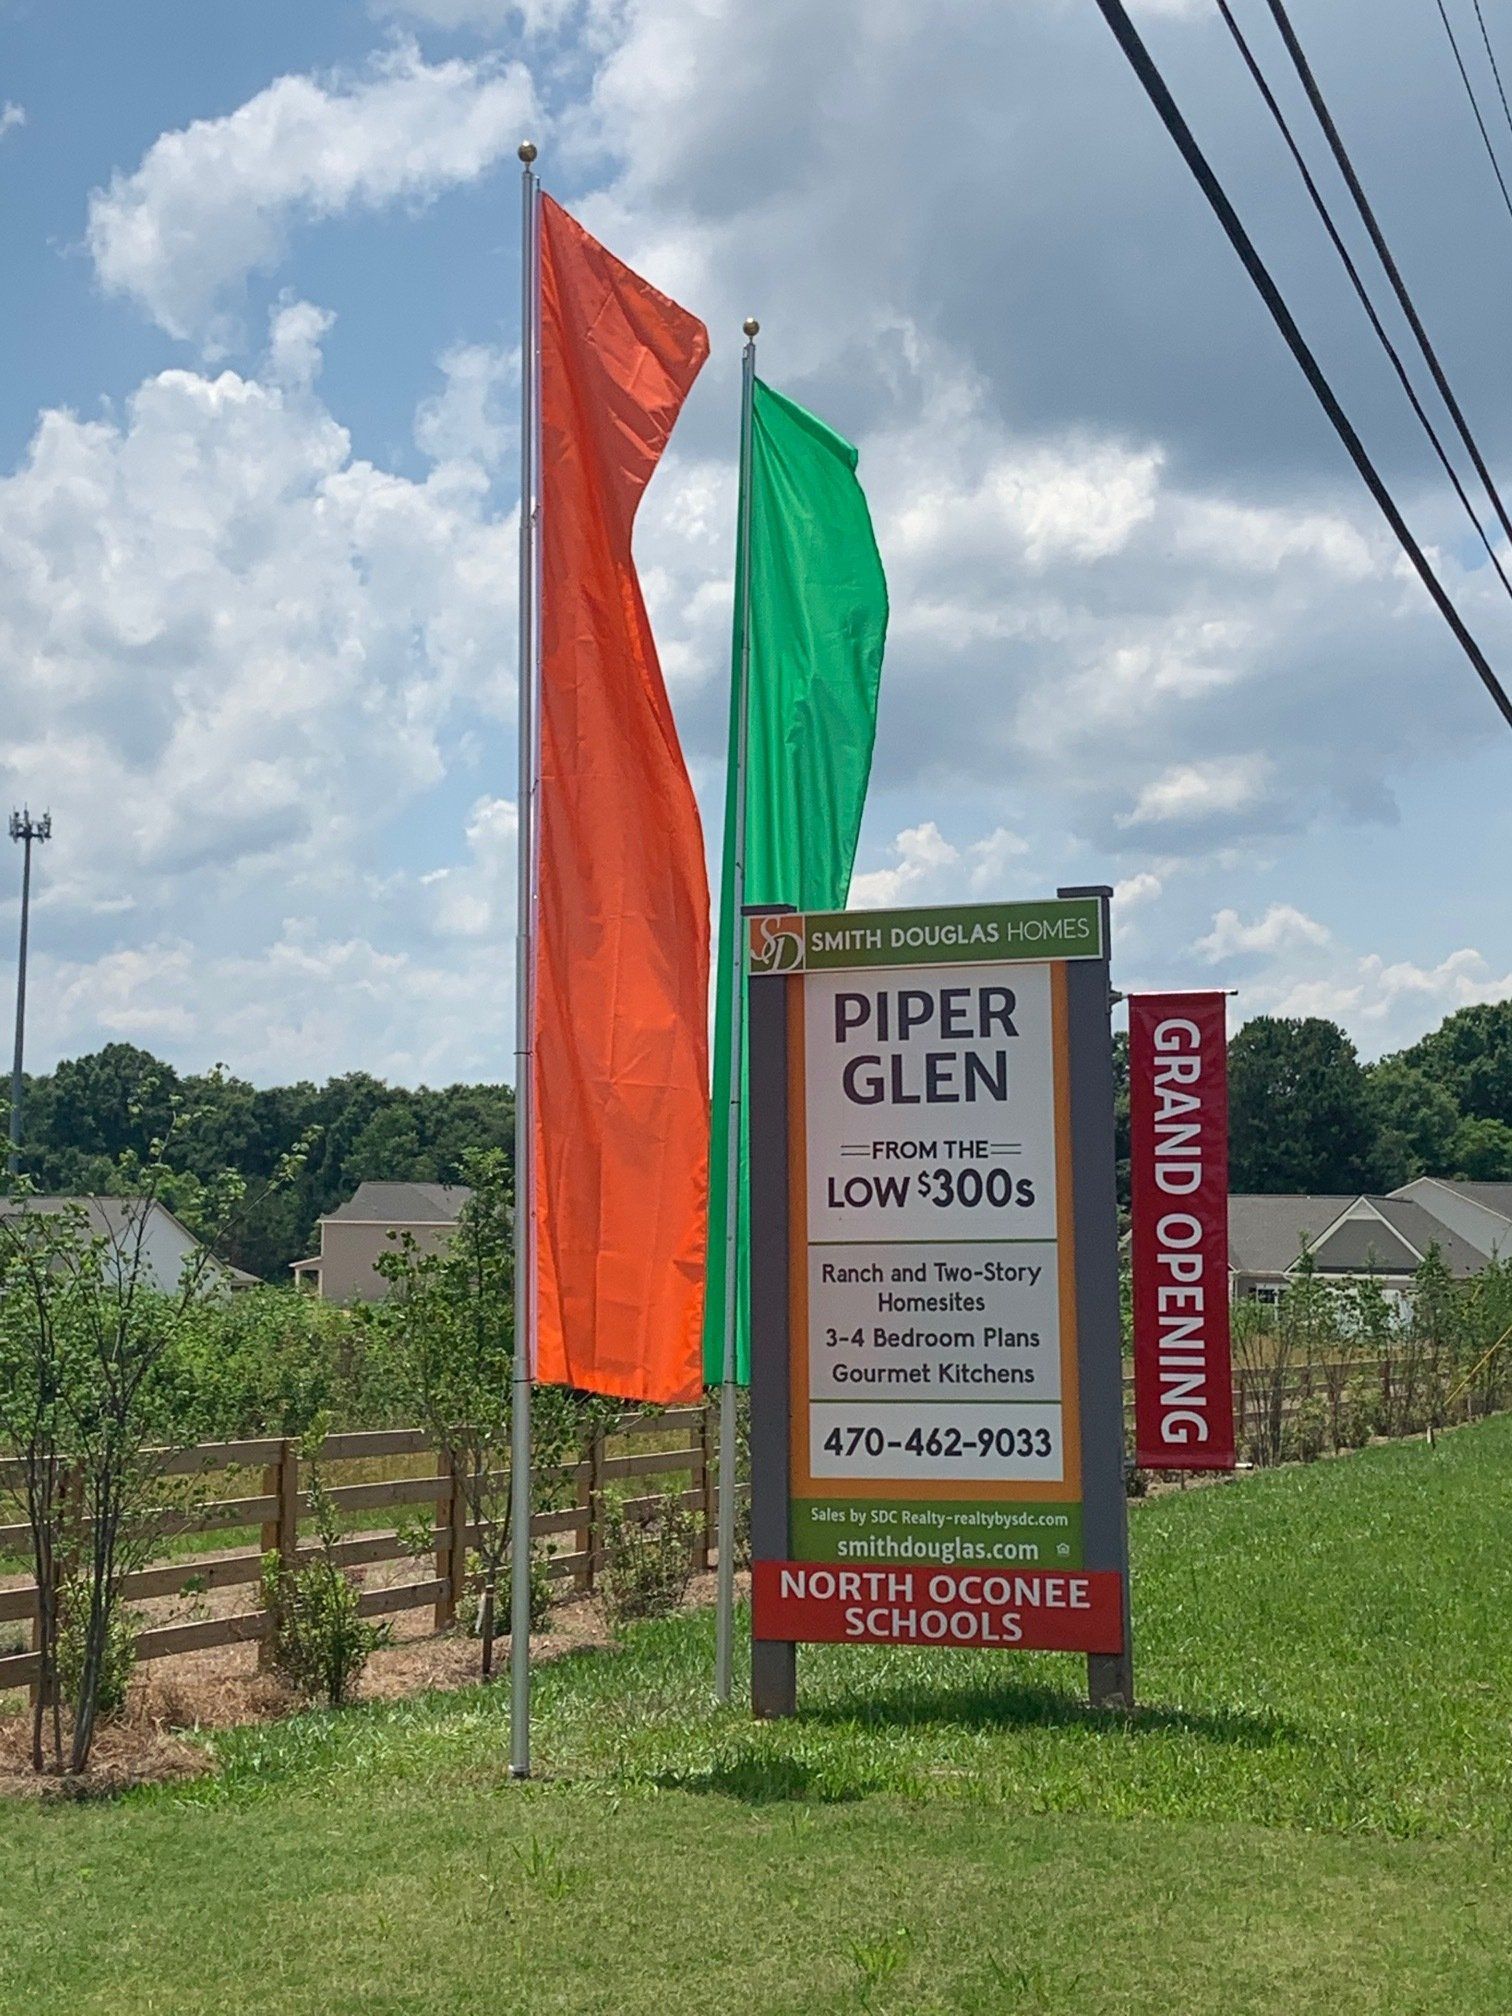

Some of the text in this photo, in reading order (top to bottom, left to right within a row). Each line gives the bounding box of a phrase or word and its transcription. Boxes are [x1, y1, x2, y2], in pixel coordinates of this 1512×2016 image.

[812, 917, 1090, 952] SMITH DOUGLAS HOMES
[835, 986, 1019, 1043] PIPER
[842, 1050, 1008, 1105] GLEN
[872, 1140, 989, 1160] FROM THE
[828, 1168, 1035, 1208] LOW $300s
[1153, 1018, 1209, 1444] GRAND OPENING
[822, 1262, 1042, 1286] Ranch and Two-Story
[878, 1293, 986, 1313] Homesites
[826, 1328, 1040, 1348] 3-4 Bedroom Plans
[832, 1364, 1035, 1385] Gourmet Kitchens
[824, 1427, 1052, 1458] 470-462-9033
[811, 1508, 1068, 1529] Sales by SDC Realty-realtybysdc.com
[837, 1536, 1039, 1564] smithdouglas.com
[780, 1570, 1091, 1609] NORTH OCONEE
[845, 1607, 1023, 1642] SCHOOLS
